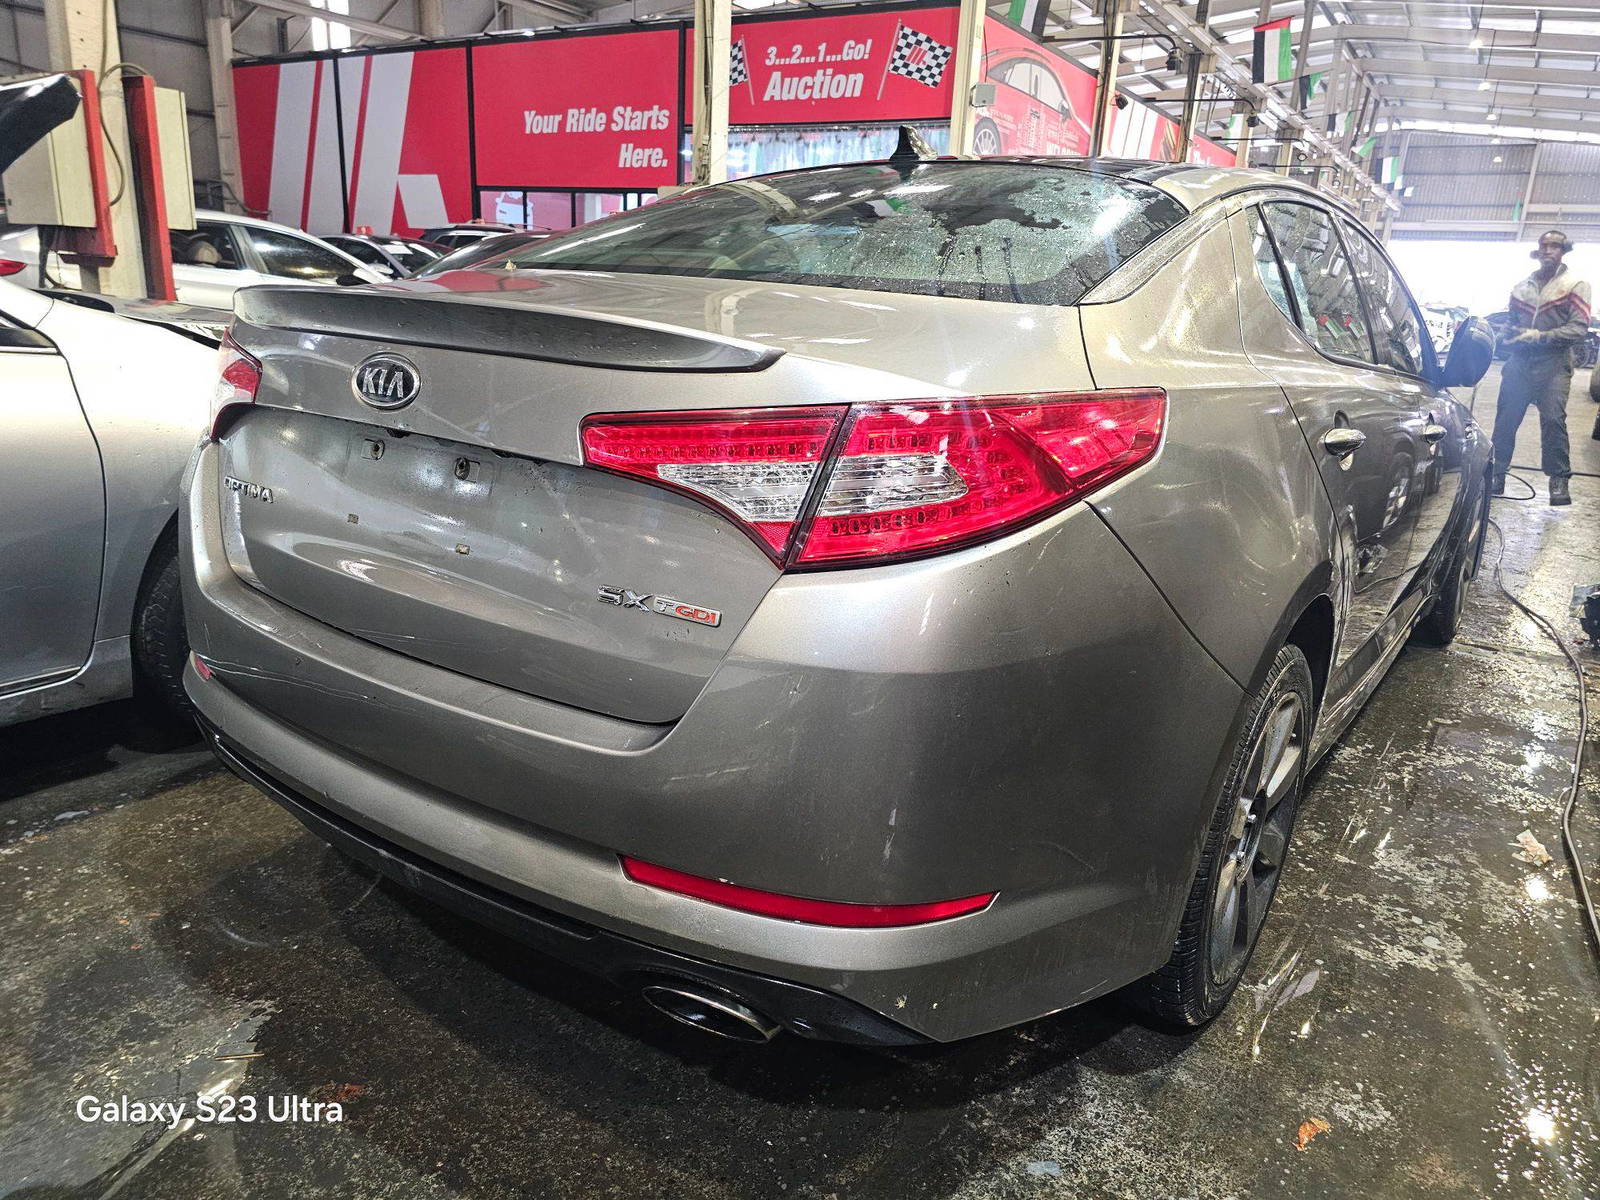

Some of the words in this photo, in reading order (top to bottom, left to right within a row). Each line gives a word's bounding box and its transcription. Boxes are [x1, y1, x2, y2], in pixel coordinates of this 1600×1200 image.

[763, 69, 864, 102] Auction
[523, 110, 562, 134] Your
[565, 107, 606, 132] Ride
[611, 105, 670, 131] Starts
[618, 144, 669, 169] Here.
[362, 366, 404, 399] KIA
